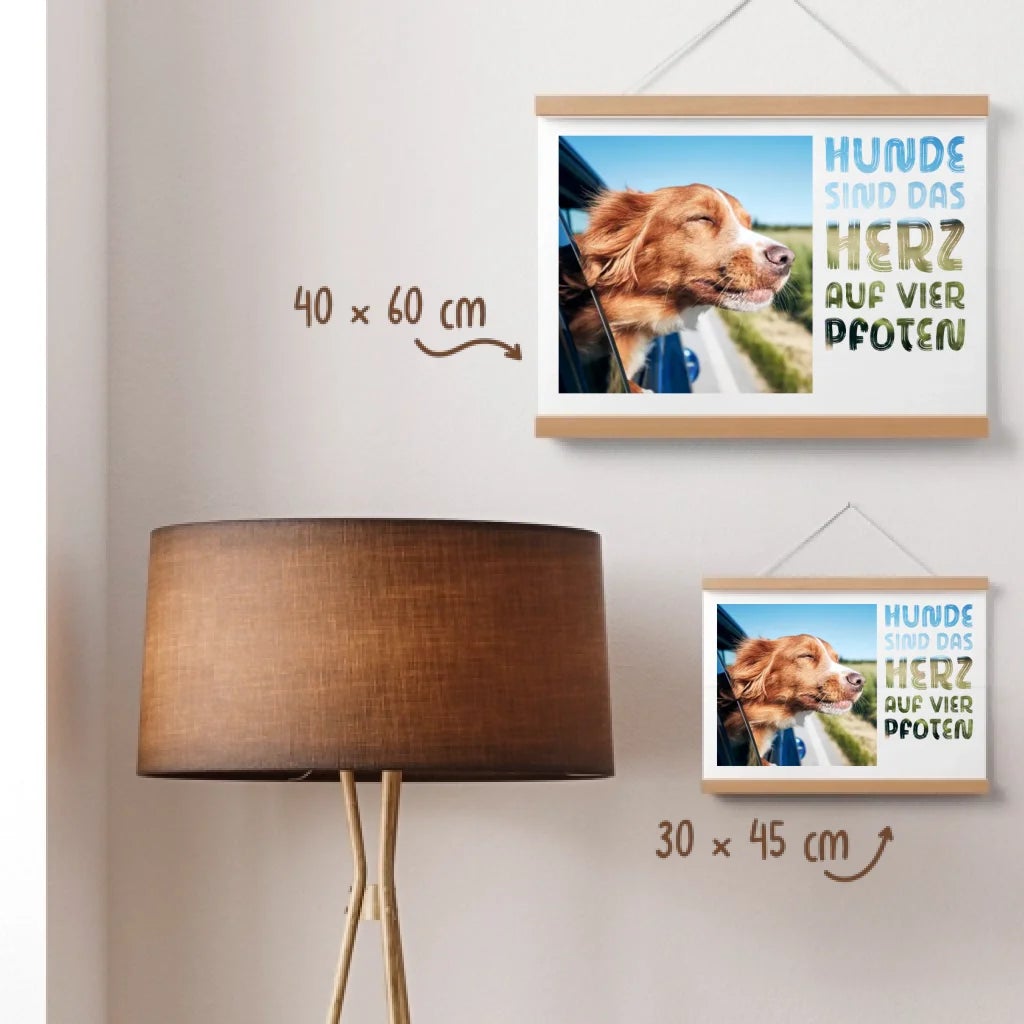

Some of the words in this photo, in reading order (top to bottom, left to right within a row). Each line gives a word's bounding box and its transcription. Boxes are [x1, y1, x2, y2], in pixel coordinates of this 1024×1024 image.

[825, 136, 965, 173] HUNDE
[825, 182, 892, 209] SIND
[908, 181, 965, 209] DAS
[826, 218, 965, 273] HERZ
[825, 280, 885, 309] AUF
[899, 281, 965, 310] VIER
[825, 317, 966, 352] PFOTEN
[885, 604, 973, 628] HUNDE
[885, 633, 929, 649] SIND
[937, 633, 973, 650] DAS
[885, 656, 973, 690] HERZ
[885, 695, 923, 713] AUF
[929, 695, 973, 714] VIER
[884, 718, 973, 740] PFOTEN
